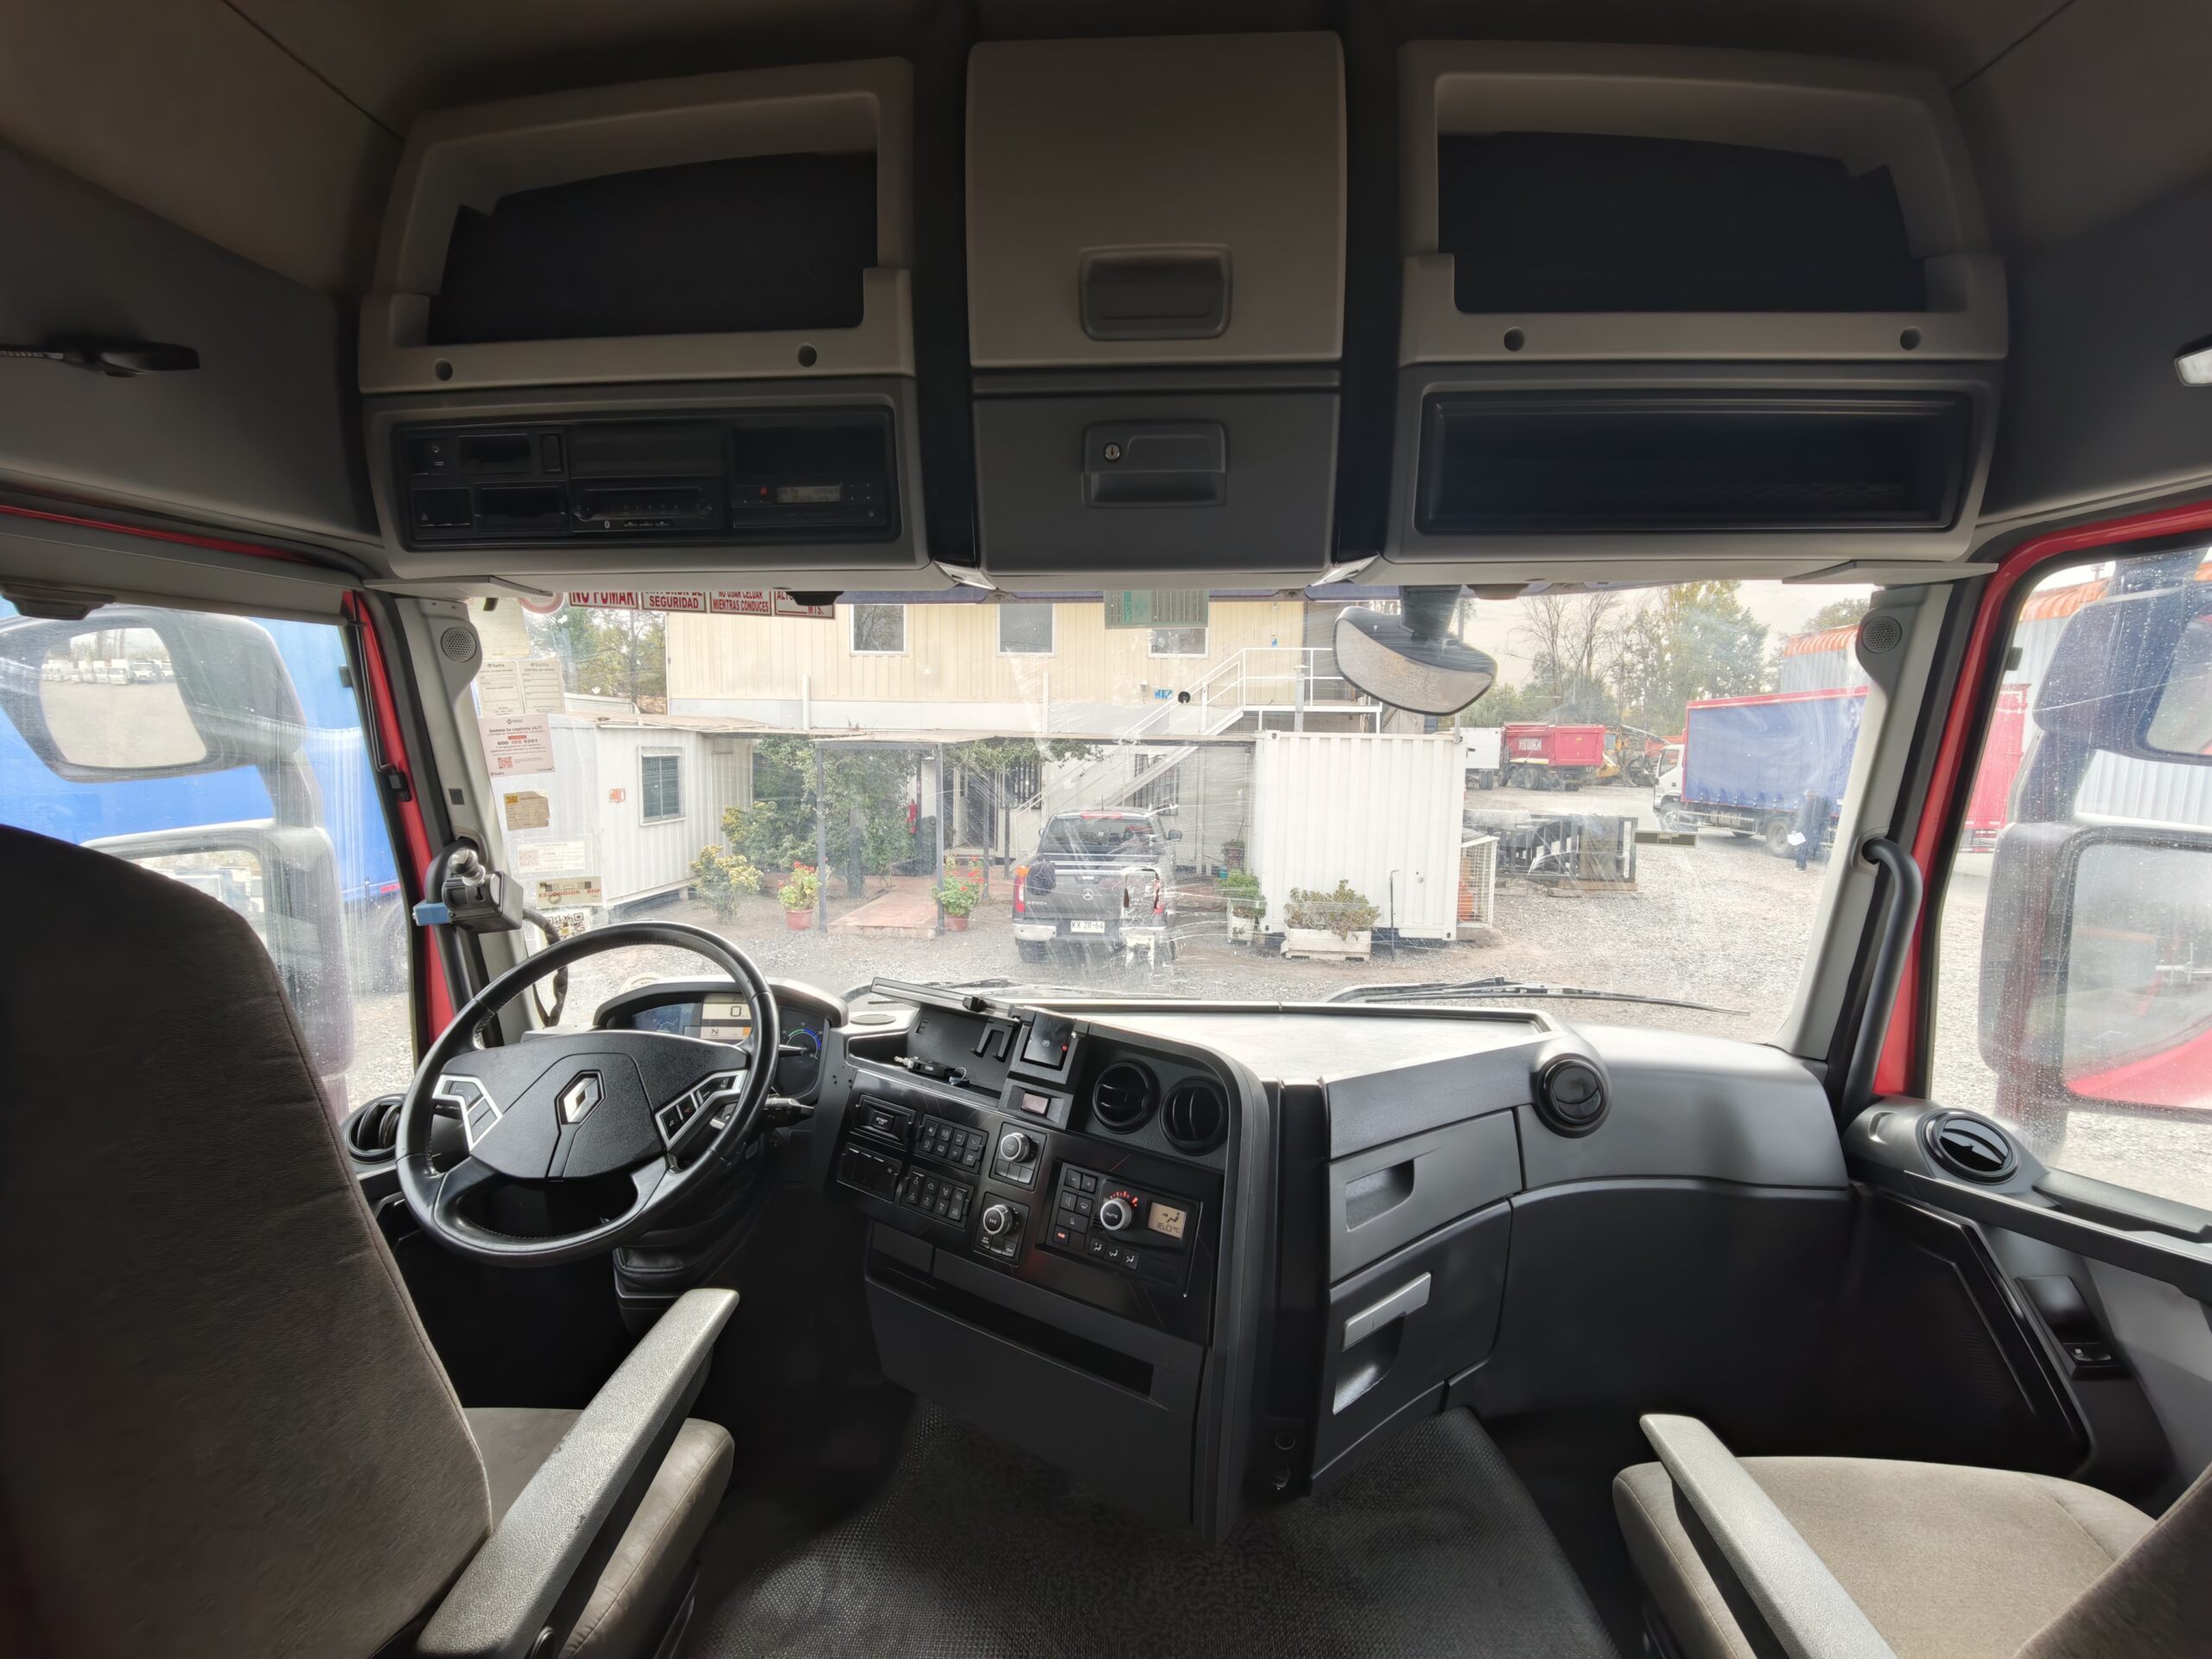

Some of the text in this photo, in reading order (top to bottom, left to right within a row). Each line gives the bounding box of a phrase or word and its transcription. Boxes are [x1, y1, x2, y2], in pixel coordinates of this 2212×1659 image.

[649, 595, 699, 609] SEGURIDAD
[713, 598, 769, 613] MIENTRAS CONDUCES
[538, 890, 581, 899] ESCONDIDA
